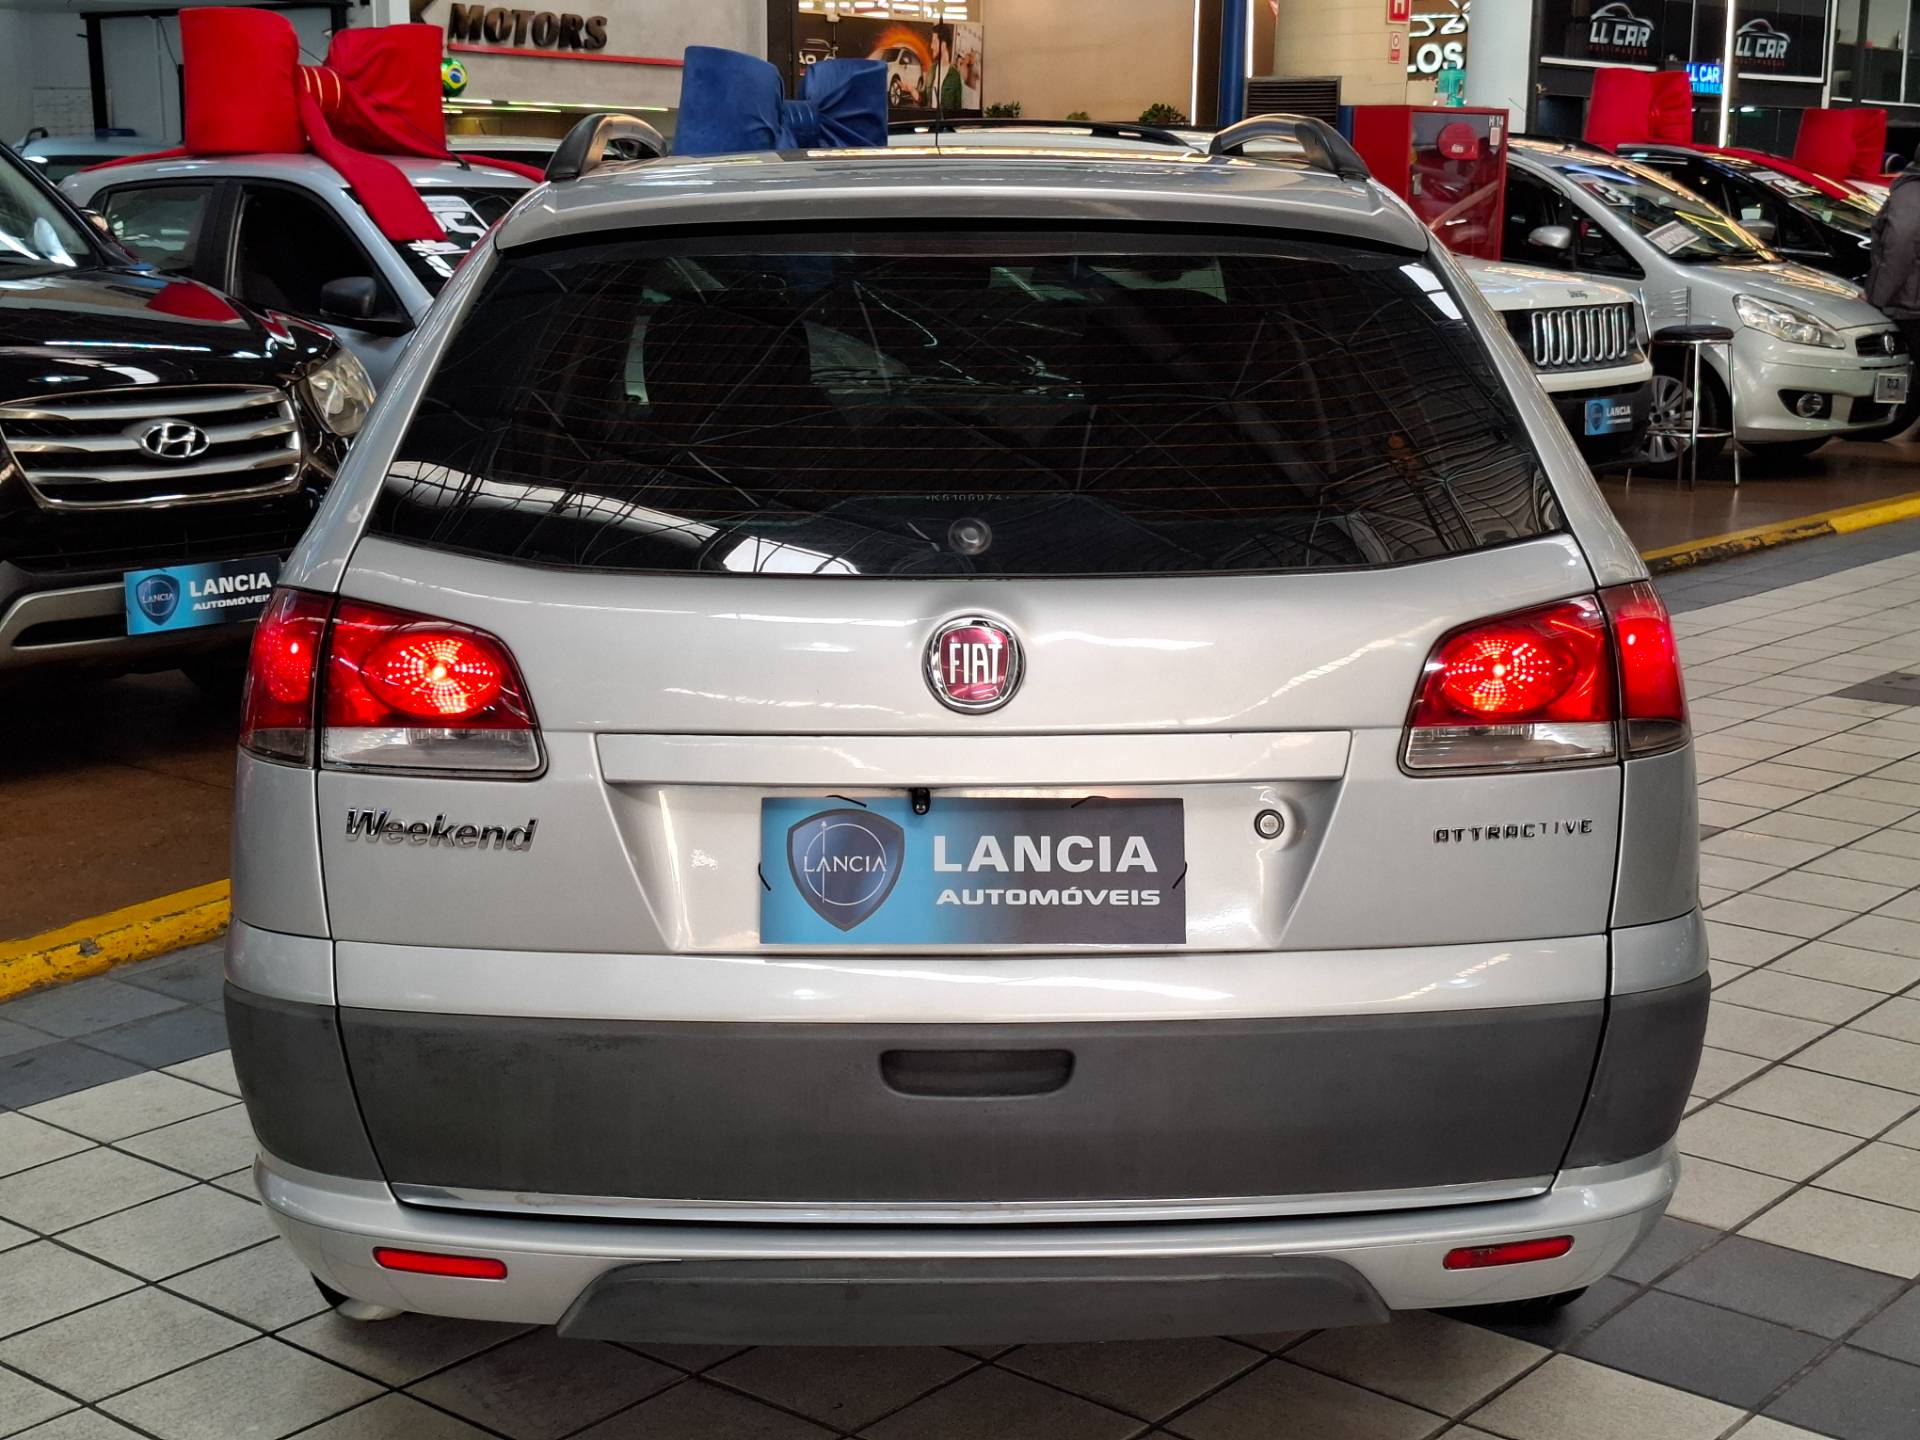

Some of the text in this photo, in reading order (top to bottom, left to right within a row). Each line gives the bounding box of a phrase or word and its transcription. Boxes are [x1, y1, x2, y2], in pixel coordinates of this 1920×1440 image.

[447, 3, 608, 50] MOTORS
[1589, 21, 1651, 48] LL CAR
[1735, 36, 1788, 59] LL CAR
[1699, 66, 1720, 85] CAR
[1606, 406, 1631, 417] LANCIA
[190, 572, 272, 597] LANCIA
[142, 592, 175, 604] LANCIA
[949, 643, 1003, 684] FIAT
[345, 807, 539, 852] Weekend
[1433, 819, 1593, 844] ATTRACTIVE
[803, 855, 887, 873] LANCIA
[933, 835, 1158, 873] LANCIA
[936, 886, 1160, 906] AUTOMÓVEIS
